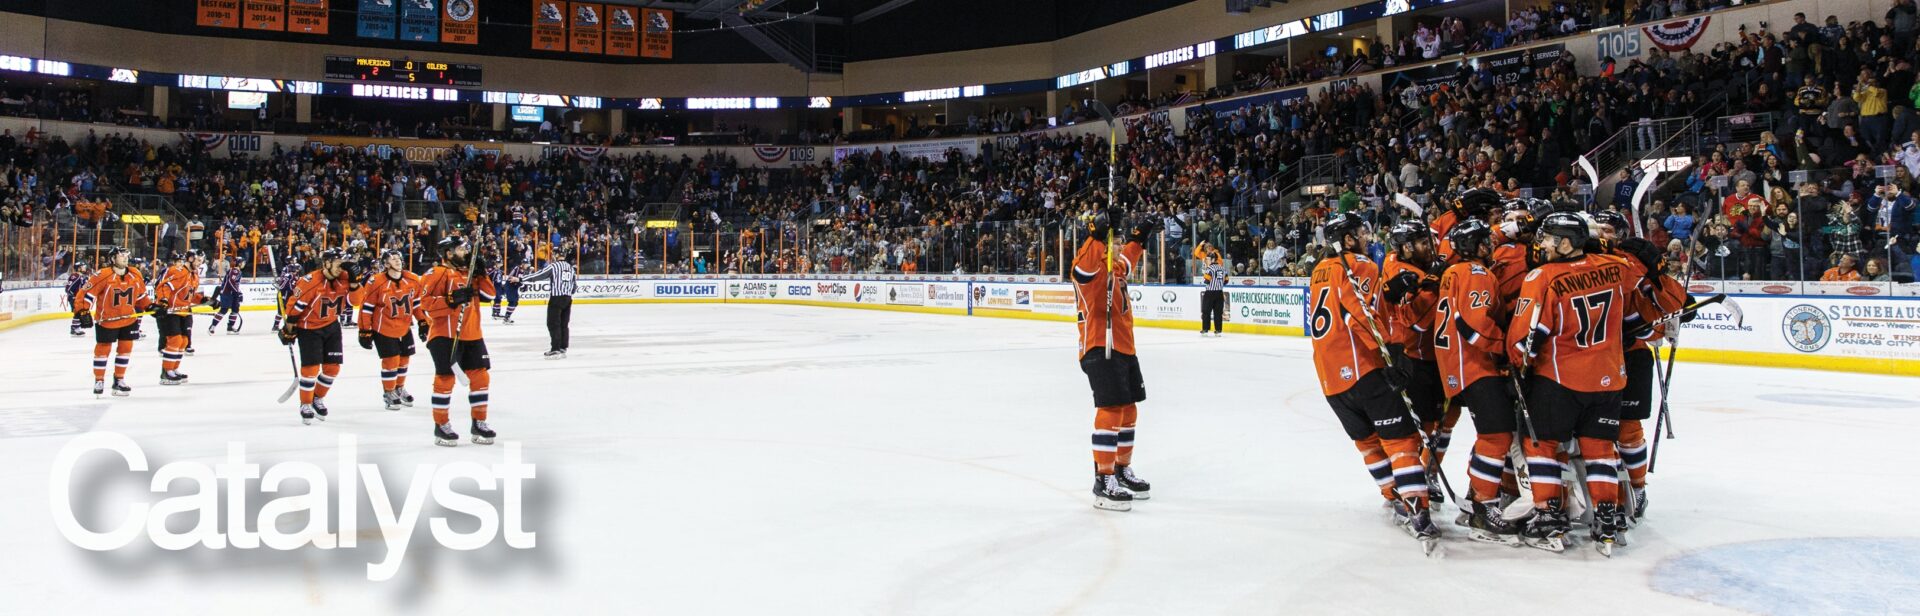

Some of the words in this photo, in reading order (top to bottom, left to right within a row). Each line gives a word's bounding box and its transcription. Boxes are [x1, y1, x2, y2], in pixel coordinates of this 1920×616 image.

[290, 9, 327, 17] CHAMPIONS
[1599, 29, 1639, 56] 105
[357, 58, 391, 67] MAVERICKS
[1145, 46, 1193, 69] MAVERICKS
[372, 67, 379, 75] 2
[426, 63, 448, 71] OILERS
[352, 84, 428, 99] MAVERICKS
[903, 87, 960, 102] MAVERICKS
[229, 134, 260, 151] 111
[406, 146, 452, 162] ORANG
[790, 146, 815, 161] 109
[1662, 157, 1688, 169] Clips
[1621, 185, 1632, 196] R
[1551, 266, 1622, 298] VANWORMER
[593, 284, 640, 294] ROOFING
[656, 286, 681, 295] BUD
[682, 285, 717, 295] LIGHT
[788, 285, 811, 296] GEICO
[862, 284, 878, 295] pepsi
[112, 286, 135, 308] M
[1231, 292, 1304, 306] MAVERICKSCHECKING.COM
[1469, 290, 1491, 309] 22
[320, 295, 345, 319] M
[389, 294, 412, 319] M
[1251, 308, 1272, 317] Central
[1274, 309, 1291, 318] Bank
[1515, 297, 1532, 317] 17
[1571, 288, 1614, 348] 17
[1695, 313, 1732, 321] ALLEY
[1835, 338, 1882, 346] KANSAS
[1838, 332, 1885, 340] OFFICIAL
[1373, 416, 1402, 426] CCM
